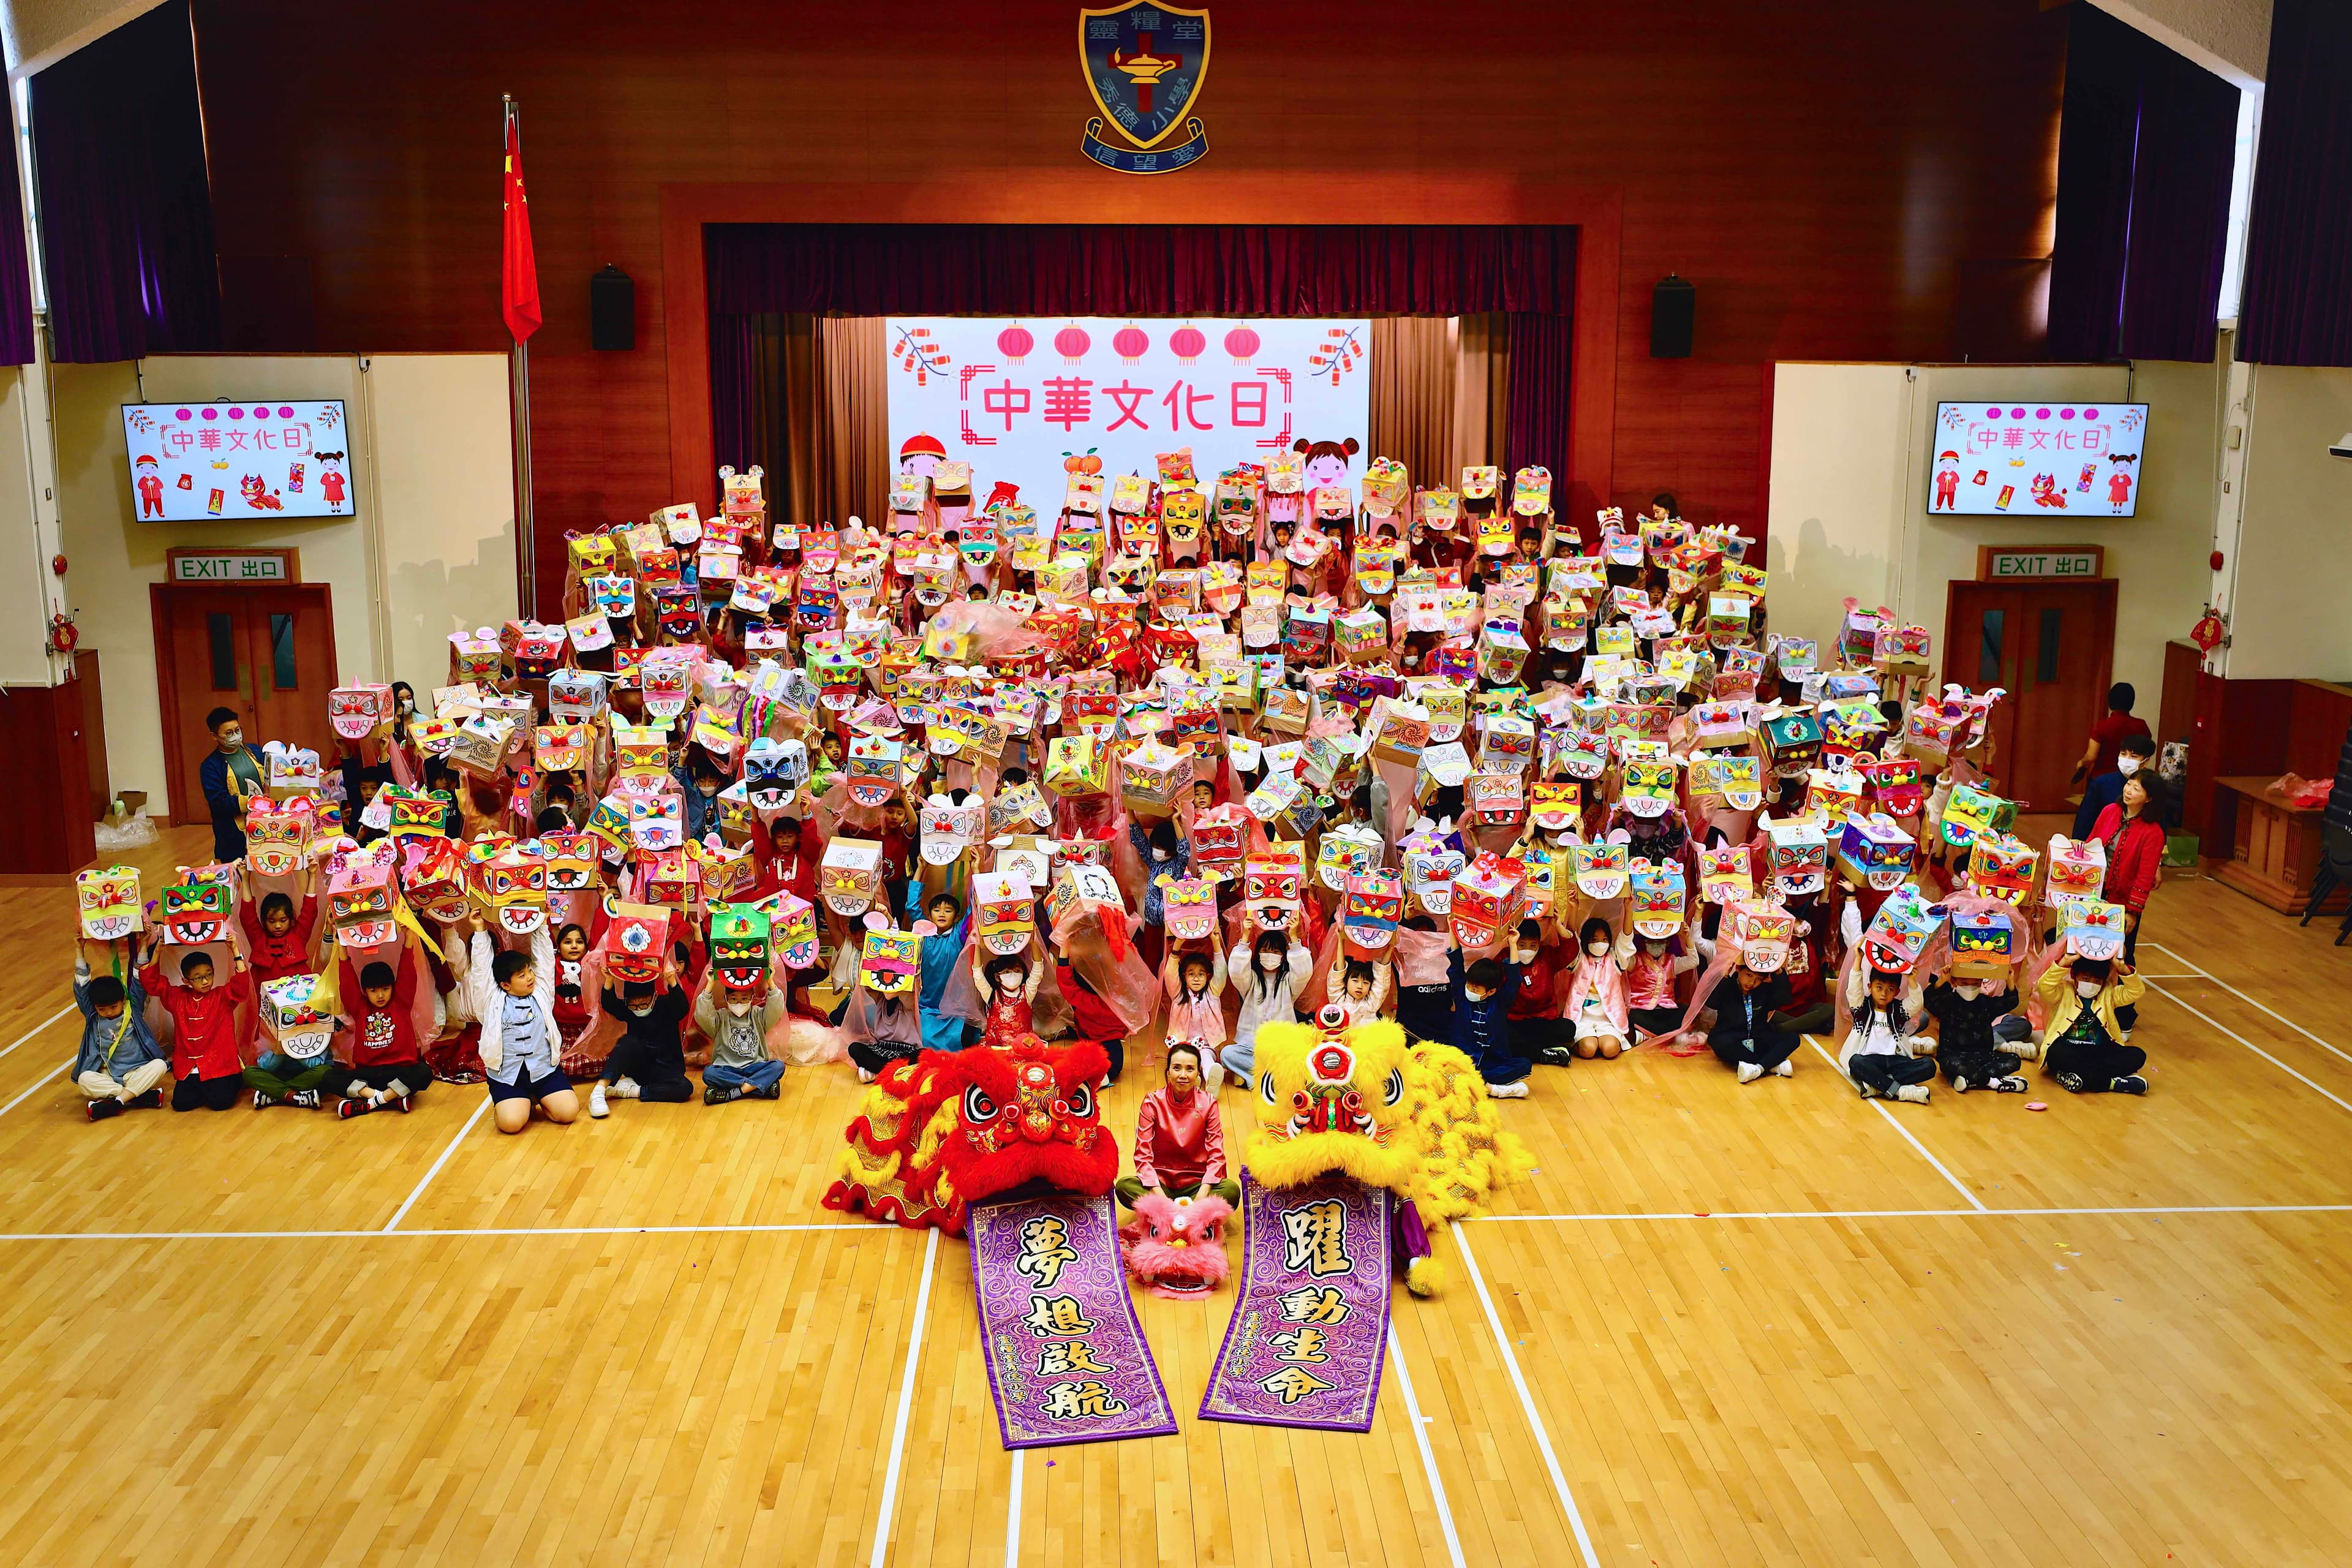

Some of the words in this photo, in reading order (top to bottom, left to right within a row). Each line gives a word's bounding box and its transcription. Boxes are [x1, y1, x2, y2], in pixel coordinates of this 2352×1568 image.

[1089, 11, 1202, 39] 靈糧堂
[1095, 145, 1197, 170] 信望愛
[983, 375, 1268, 432] 中華文化日
[171, 428, 301, 453] 中華文化日
[1977, 427, 2100, 450] 中華文化日
[182, 559, 232, 578] EXIT
[241, 560, 277, 577] 出口
[1999, 557, 2047, 575] EXIT
[2055, 557, 2089, 574] 出口
[1254, 1198, 1354, 1405] 躍動生命
[1015, 1215, 1129, 1420] 夢想啟航
